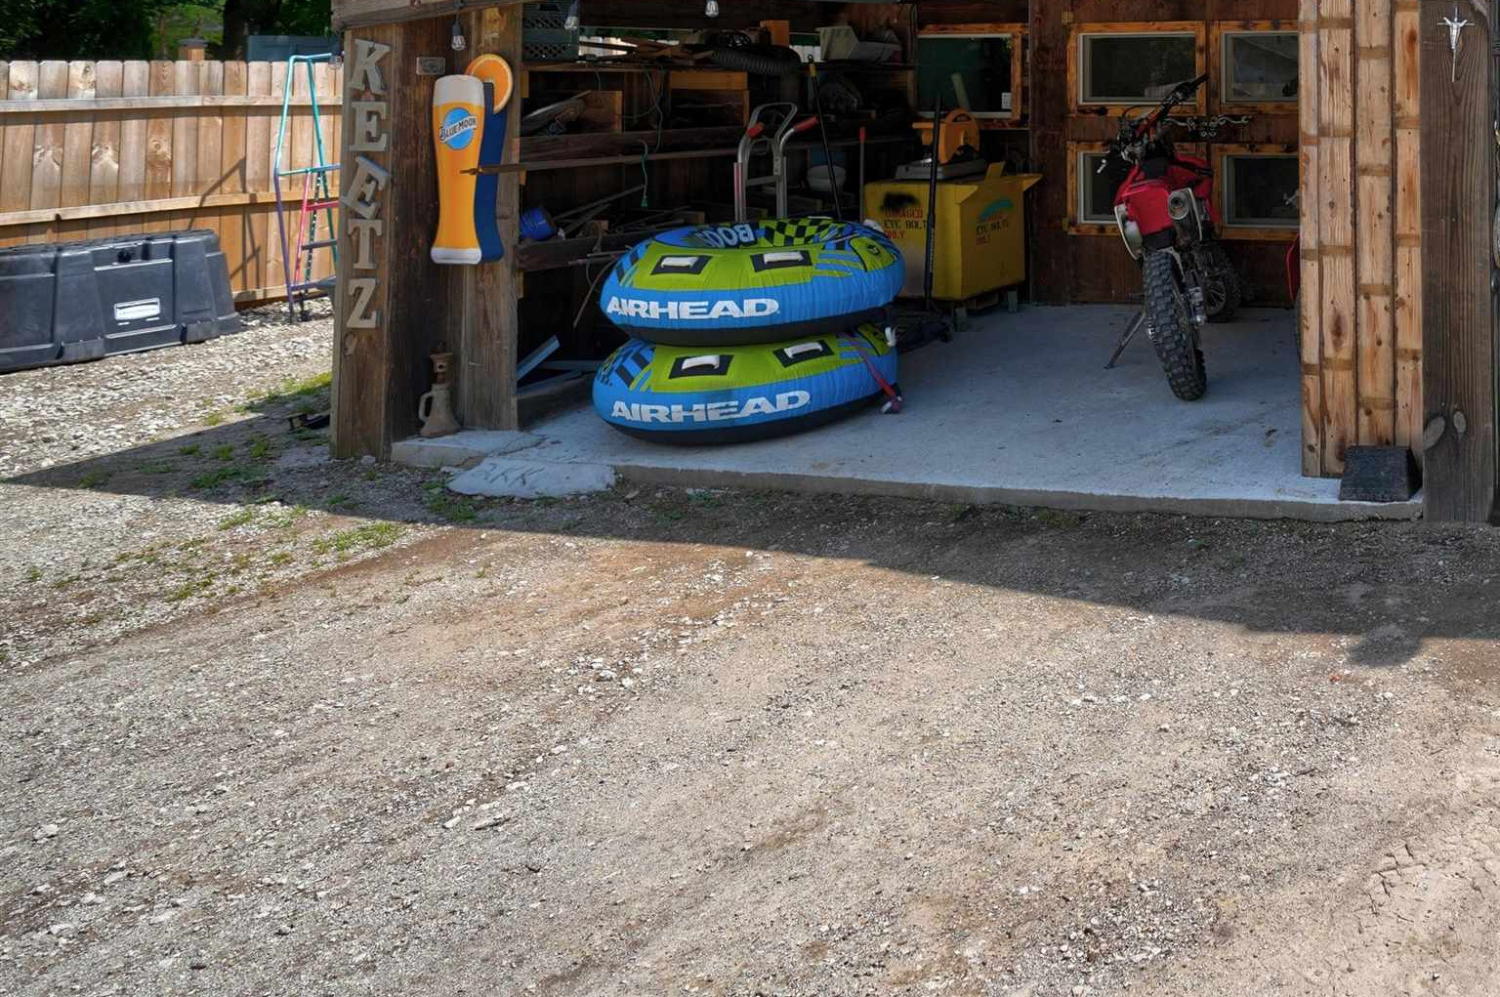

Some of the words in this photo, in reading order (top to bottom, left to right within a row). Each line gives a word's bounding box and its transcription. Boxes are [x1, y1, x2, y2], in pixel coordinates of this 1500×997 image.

[439, 126, 458, 141] BLUE
[341, 38, 391, 328] KEETZ
[606, 296, 780, 320] AIRHEAD
[610, 390, 811, 422] AIRHEAD
